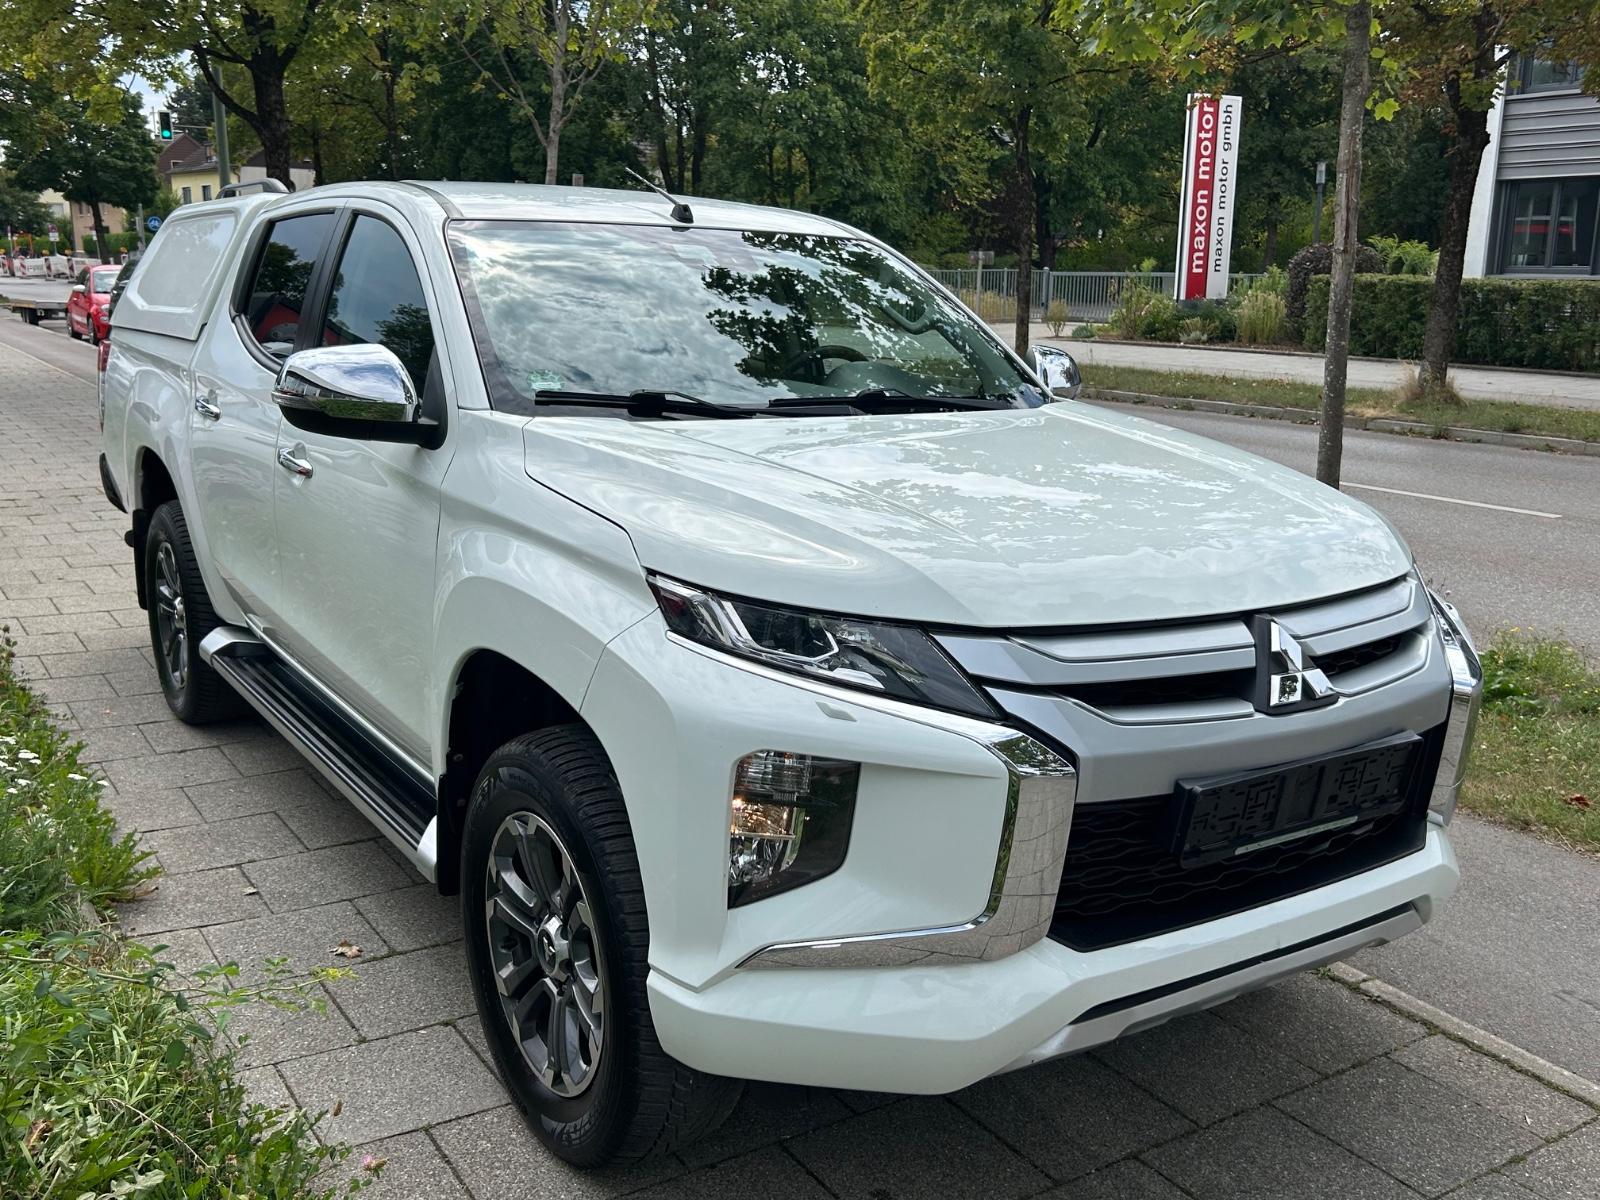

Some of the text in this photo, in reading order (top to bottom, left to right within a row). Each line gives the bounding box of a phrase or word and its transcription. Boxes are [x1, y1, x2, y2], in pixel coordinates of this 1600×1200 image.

[1192, 102, 1214, 273] maxon motor
[1214, 104, 1233, 273] maxon motor gmbh
